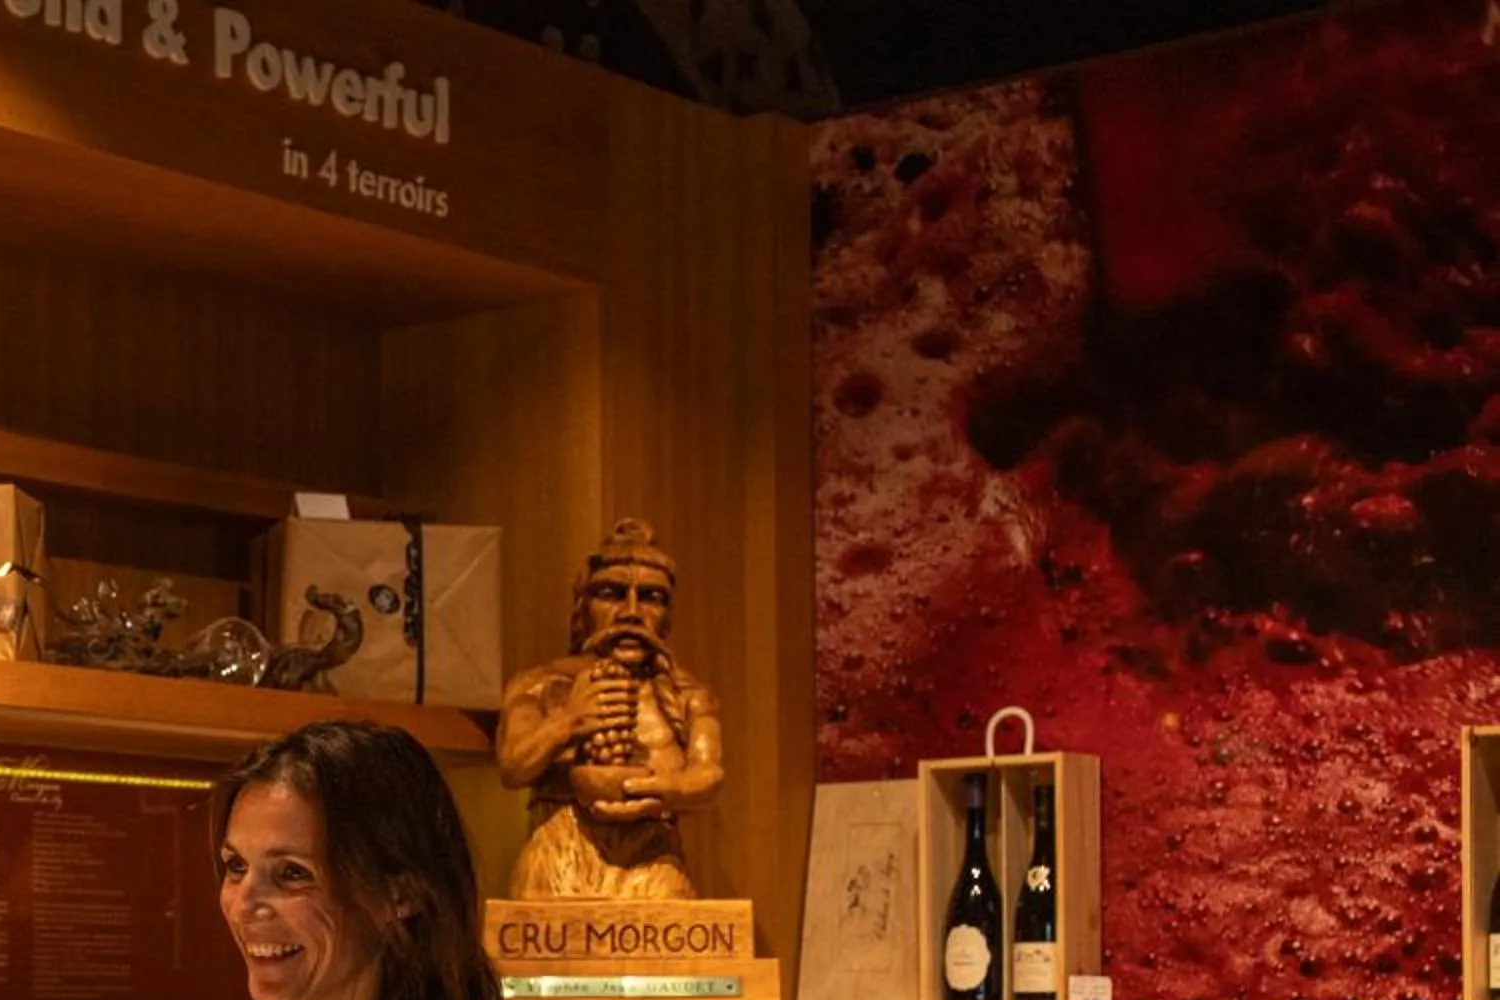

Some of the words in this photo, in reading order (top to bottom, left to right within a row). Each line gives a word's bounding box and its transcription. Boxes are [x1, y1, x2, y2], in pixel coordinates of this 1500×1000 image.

[143, 0, 190, 66] &
[213, 7, 451, 143] Powerful
[282, 138, 308, 179] in
[319, 149, 339, 187] 4
[347, 161, 449, 217] terroirs
[499, 922, 568, 954] CRU
[585, 922, 735, 954] MORGON
